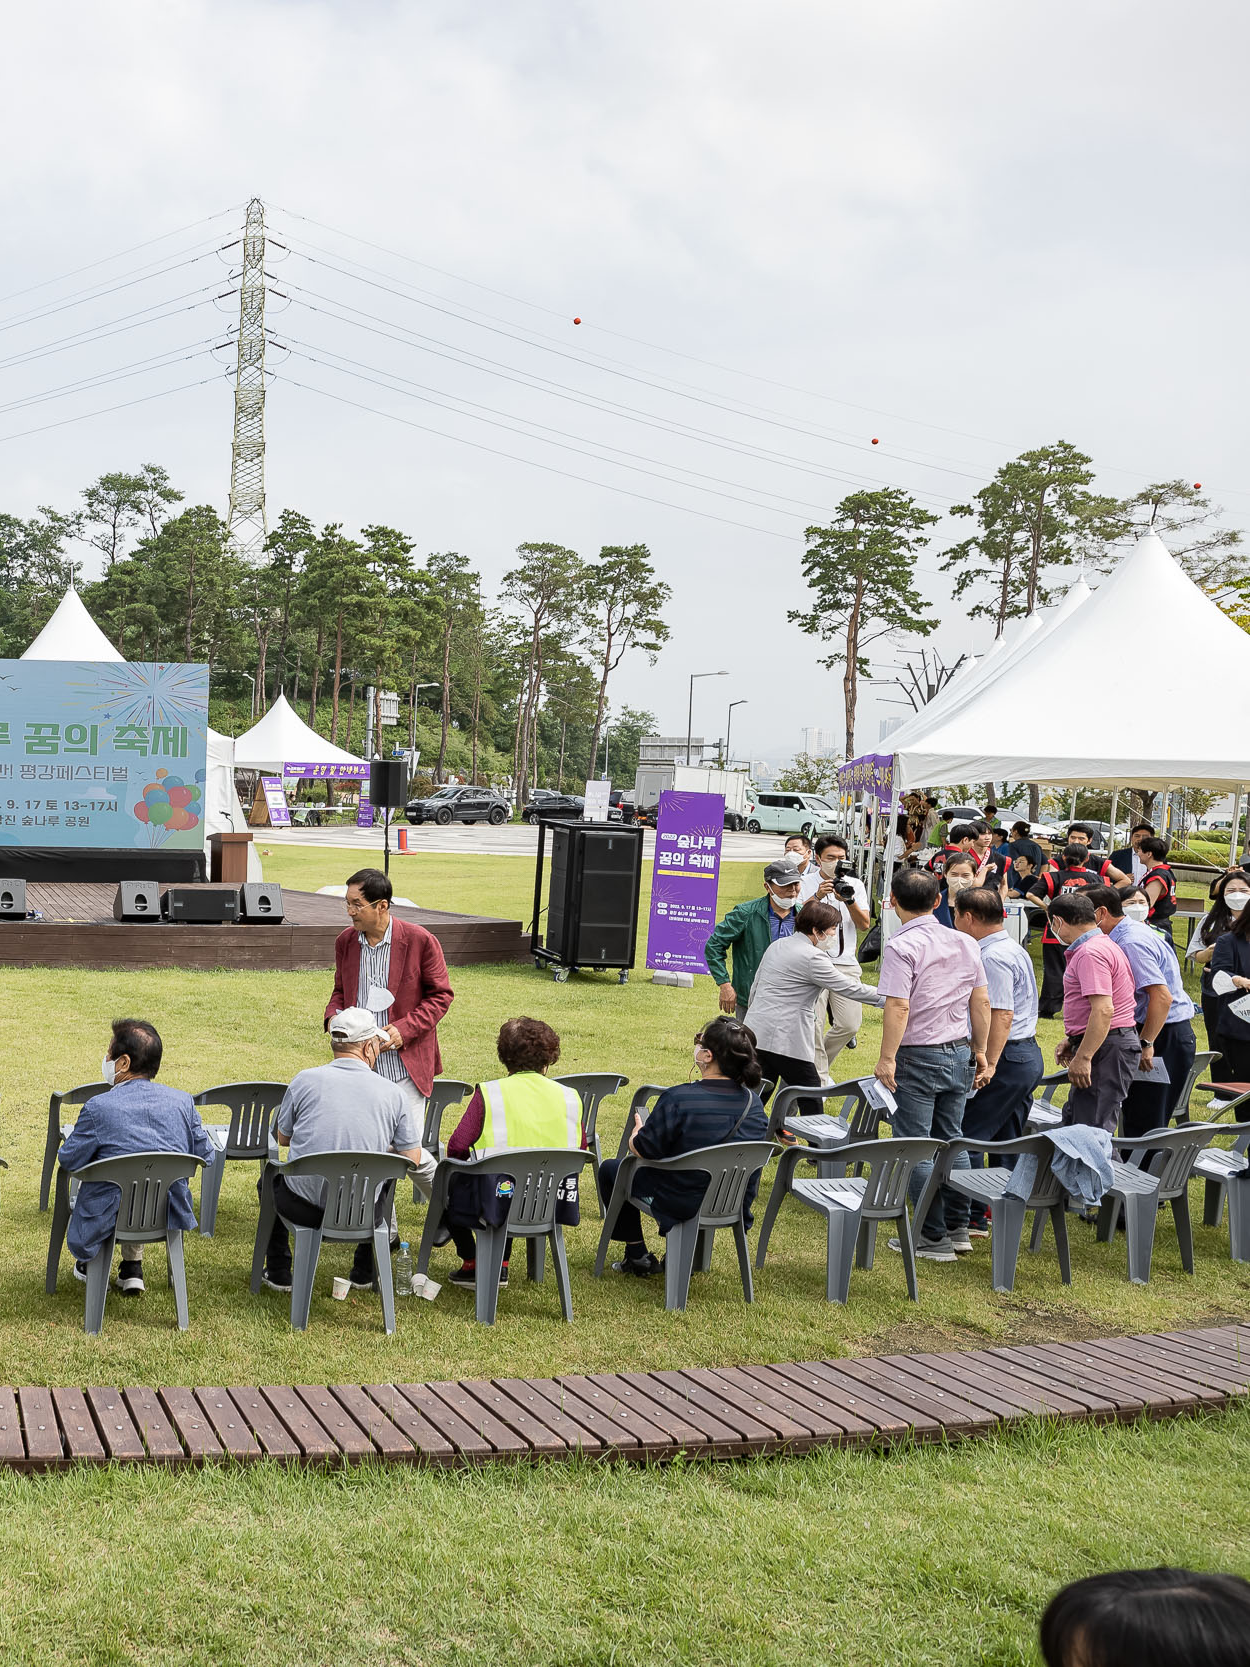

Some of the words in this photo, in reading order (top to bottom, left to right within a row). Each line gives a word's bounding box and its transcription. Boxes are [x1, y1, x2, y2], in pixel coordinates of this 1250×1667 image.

[23, 720, 100, 756] 꿈의
[111, 722, 189, 758] 축제
[19, 763, 129, 782] 평강페스티벌
[6, 799, 20, 810] 9.
[24, 800, 41, 811] 17
[46, 800, 58, 811] 토
[63, 800, 118, 812] 13~17시
[21, 814, 60, 827] 숲나루
[64, 815, 90, 828] 공원
[677, 834, 716, 851] 숲나루
[659, 851, 685, 867] 꿈의
[688, 853, 715, 869] 축제
